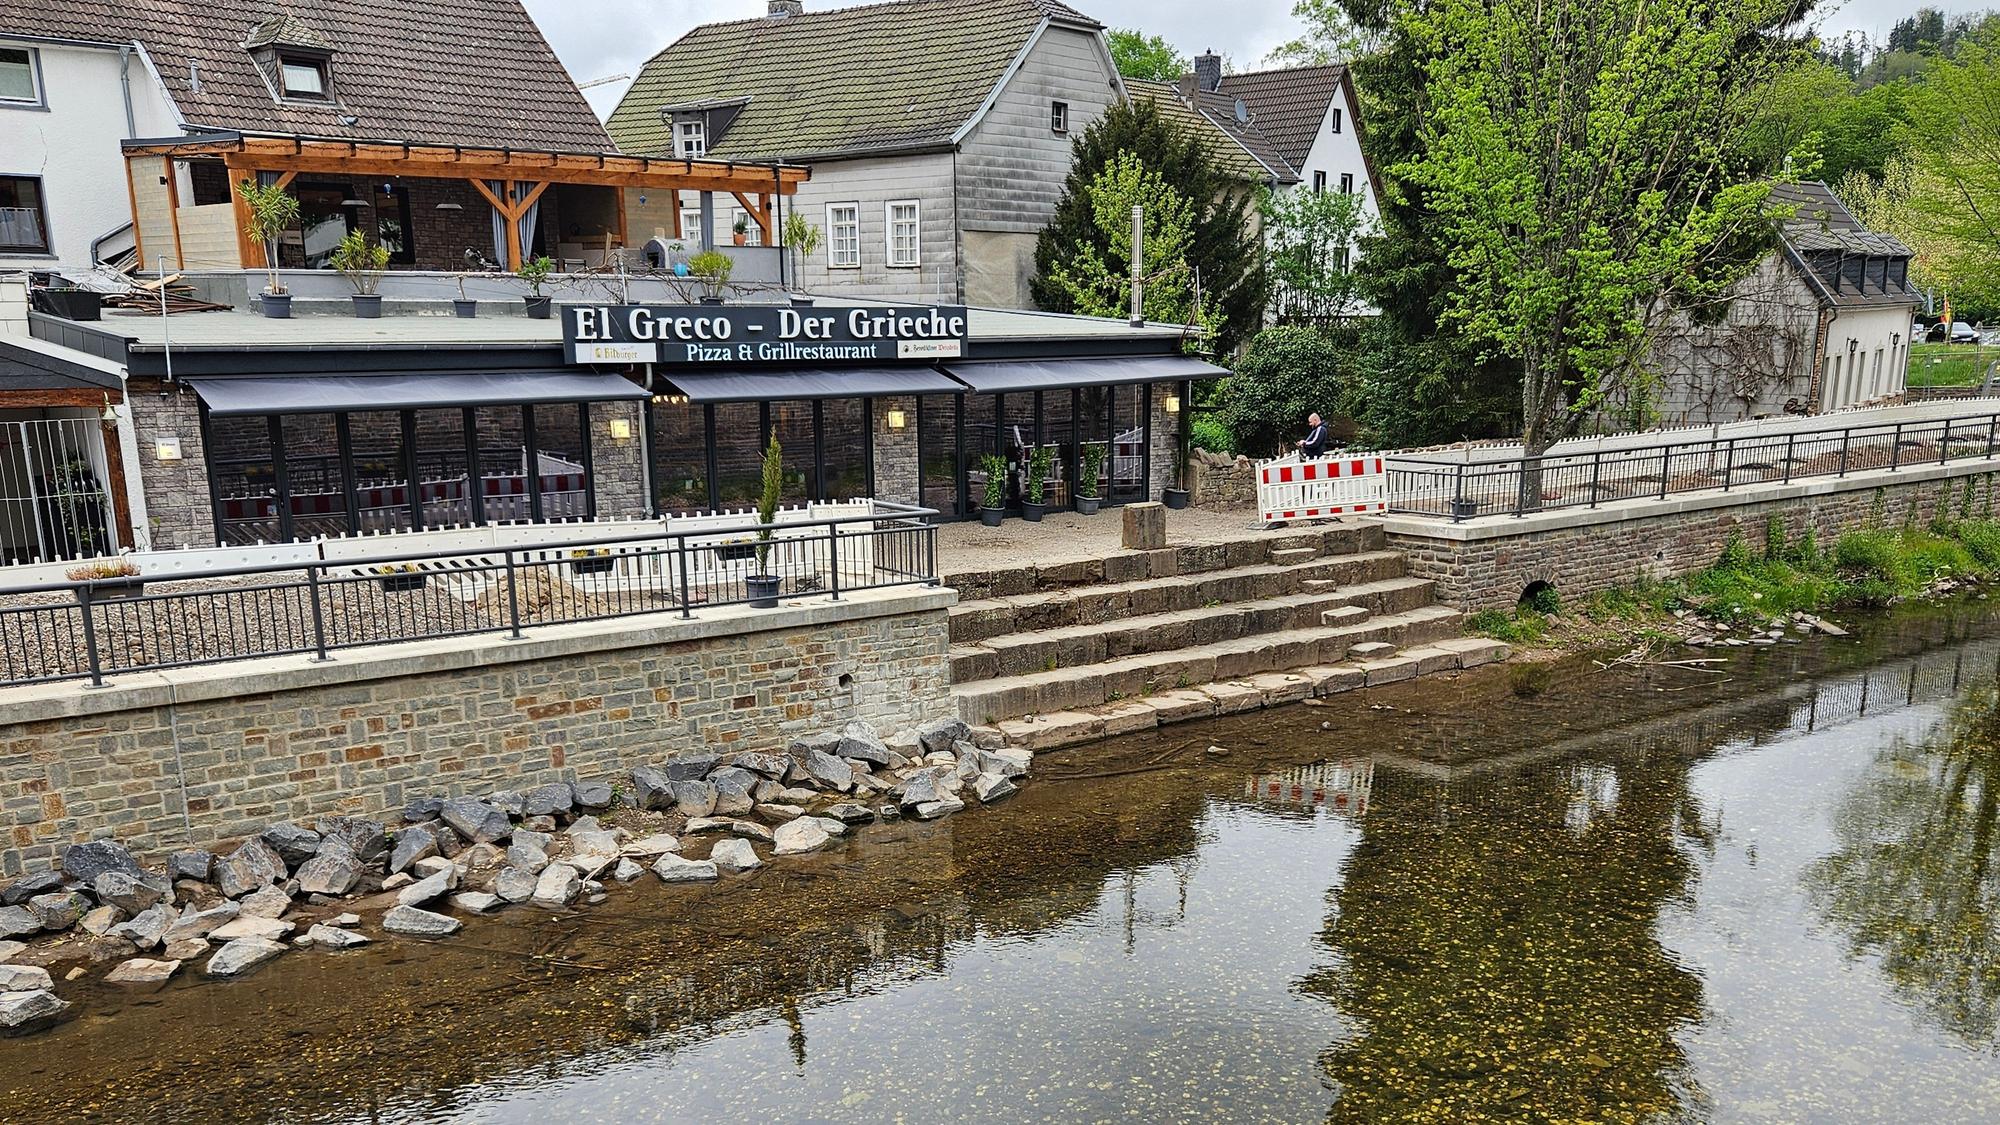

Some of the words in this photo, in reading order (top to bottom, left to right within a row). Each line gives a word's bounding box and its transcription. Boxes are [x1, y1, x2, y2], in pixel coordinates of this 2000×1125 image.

[573, 307, 613, 340] El
[629, 308, 732, 340] Greco
[777, 309, 836, 339] Der
[848, 308, 964, 338] Grieche
[686, 343, 733, 362] Pizza
[738, 343, 753, 361] &
[758, 342, 877, 361] Grillrestaurant
